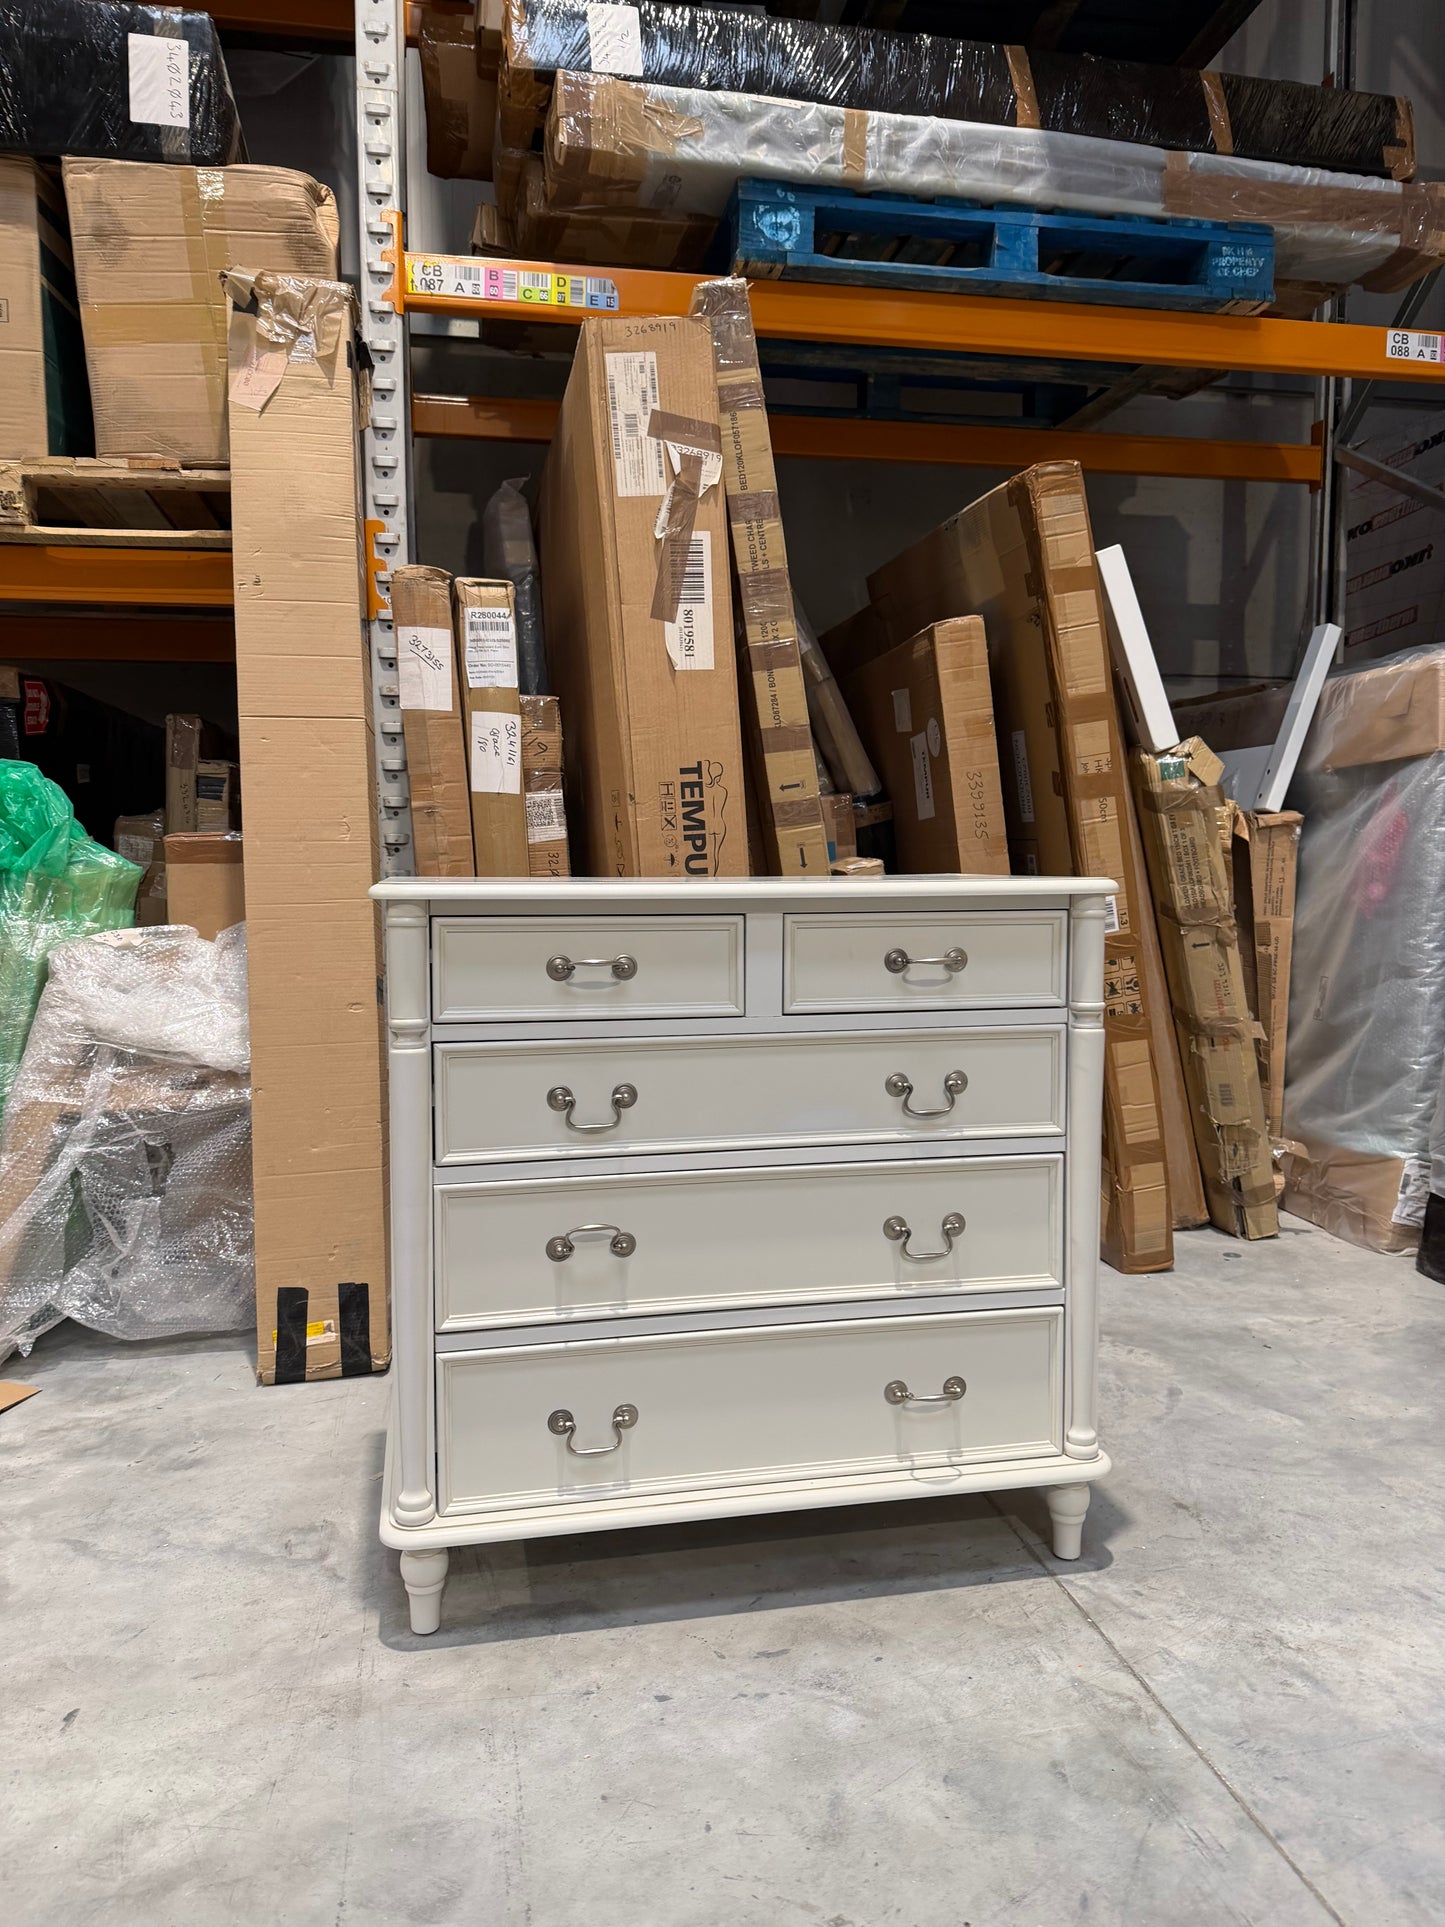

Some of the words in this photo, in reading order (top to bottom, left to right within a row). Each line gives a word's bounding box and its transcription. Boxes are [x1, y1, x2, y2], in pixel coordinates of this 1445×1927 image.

[422, 265, 442, 277] CB
[489, 270, 499, 281] B
[420, 277, 444, 292] 087
[454, 282, 465, 293] A
[557, 276, 567, 287] D
[522, 289, 533, 300] C
[590, 295, 599, 306] E
[624, 322, 677, 338] 3268919
[1393, 332, 1409, 345] CB
[1391, 345, 1410, 357] 088
[1417, 349, 1426, 359] A
[745, 519, 756, 542] CHAR
[683, 608, 695, 659] 8019581
[680, 760, 708, 877] TEMPU
